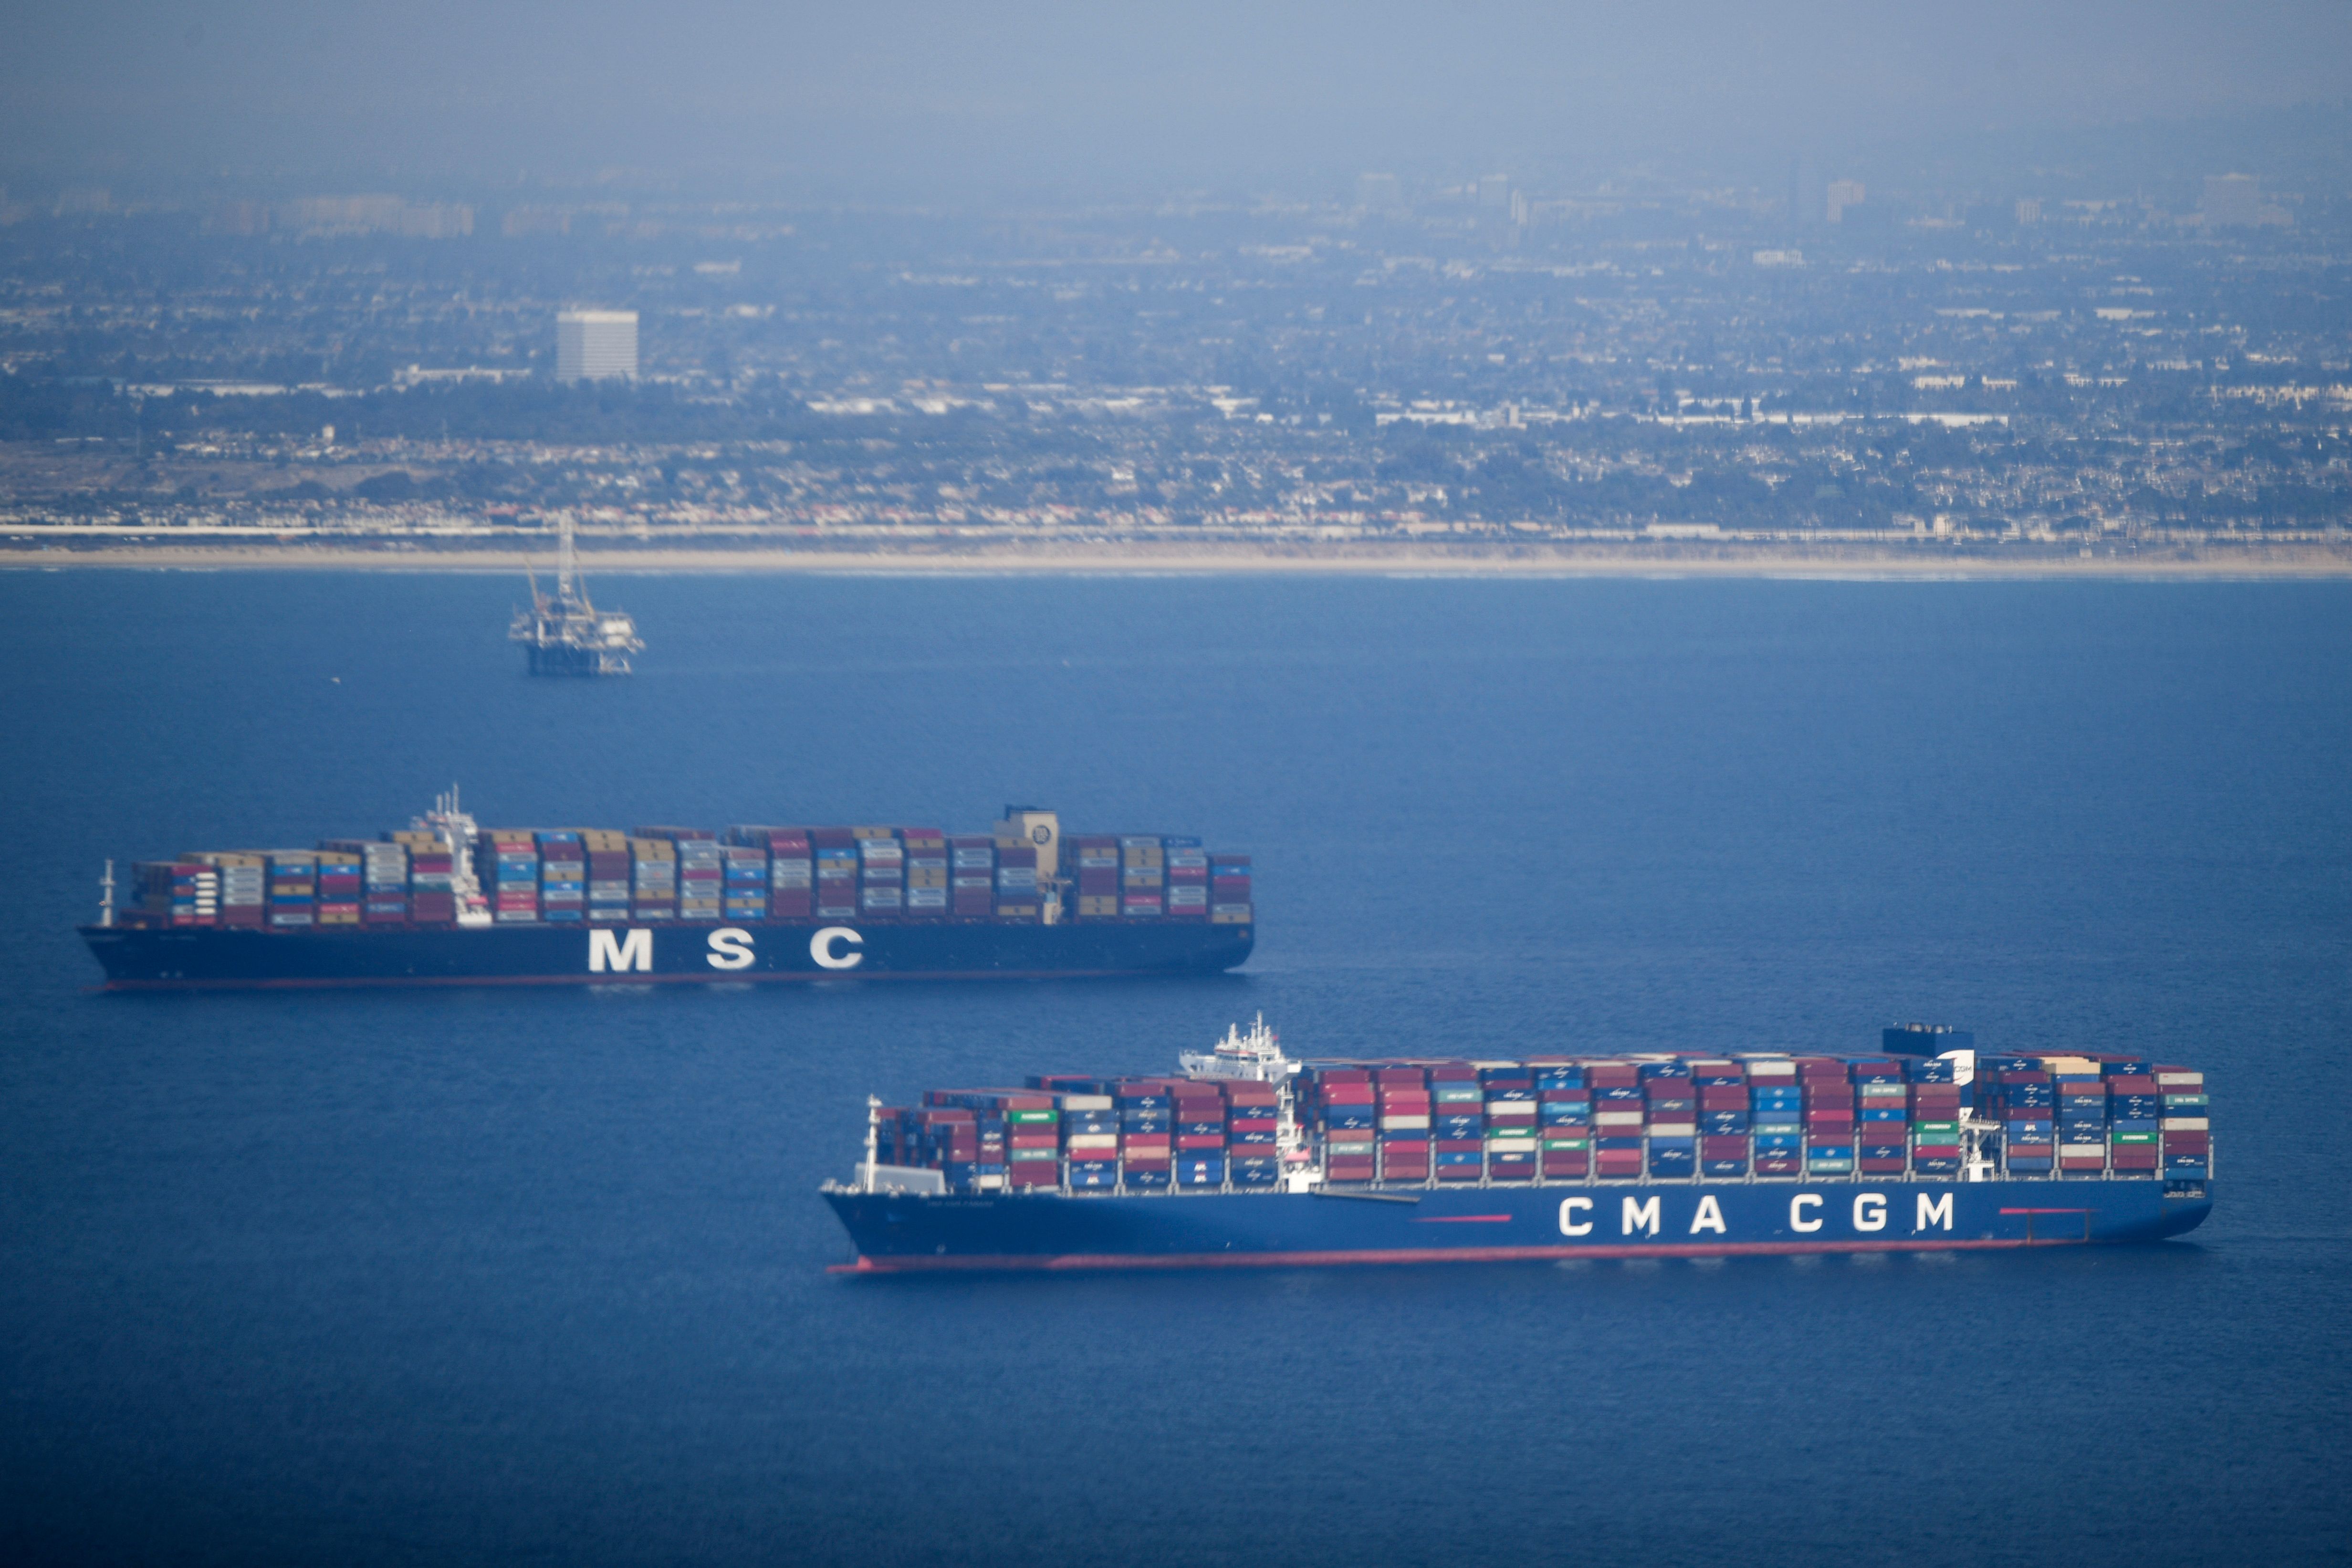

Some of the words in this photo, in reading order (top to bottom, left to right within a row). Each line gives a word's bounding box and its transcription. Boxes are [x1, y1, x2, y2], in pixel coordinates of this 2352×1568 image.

[589, 927, 863, 972] MSC
[1558, 1195, 1726, 1236] CMA
[1790, 1192, 1953, 1233] CGM
